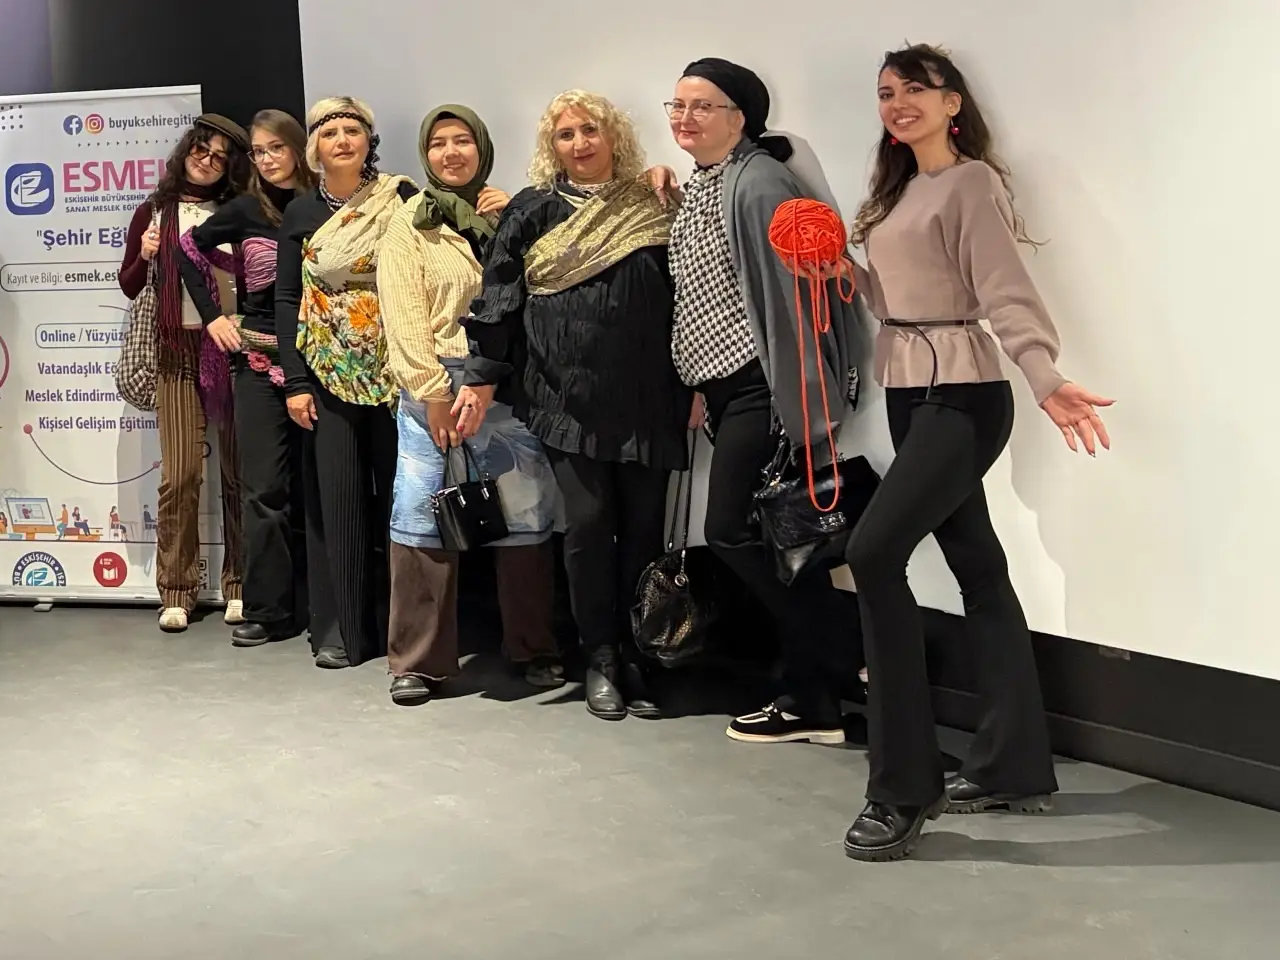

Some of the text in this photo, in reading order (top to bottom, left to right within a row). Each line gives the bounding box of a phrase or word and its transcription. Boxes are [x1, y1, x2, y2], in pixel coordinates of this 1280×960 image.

[64, 193, 146, 203] ESKİŞEHİR BÜYÜKŞEHİR
[37, 228, 92, 251] "Şehir
[7, 273, 28, 286] Kayıt
[41, 272, 62, 286] Bilgi:
[40, 330, 76, 342] Online
[78, 328, 83, 342] /
[38, 362, 102, 377] Vatandaşlık
[25, 389, 121, 402] Meslek Edindirme
[39, 417, 73, 432] Kişisel
[75, 416, 116, 432] Gelişim
[21, 552, 56, 567] ESKİŞEHİR
